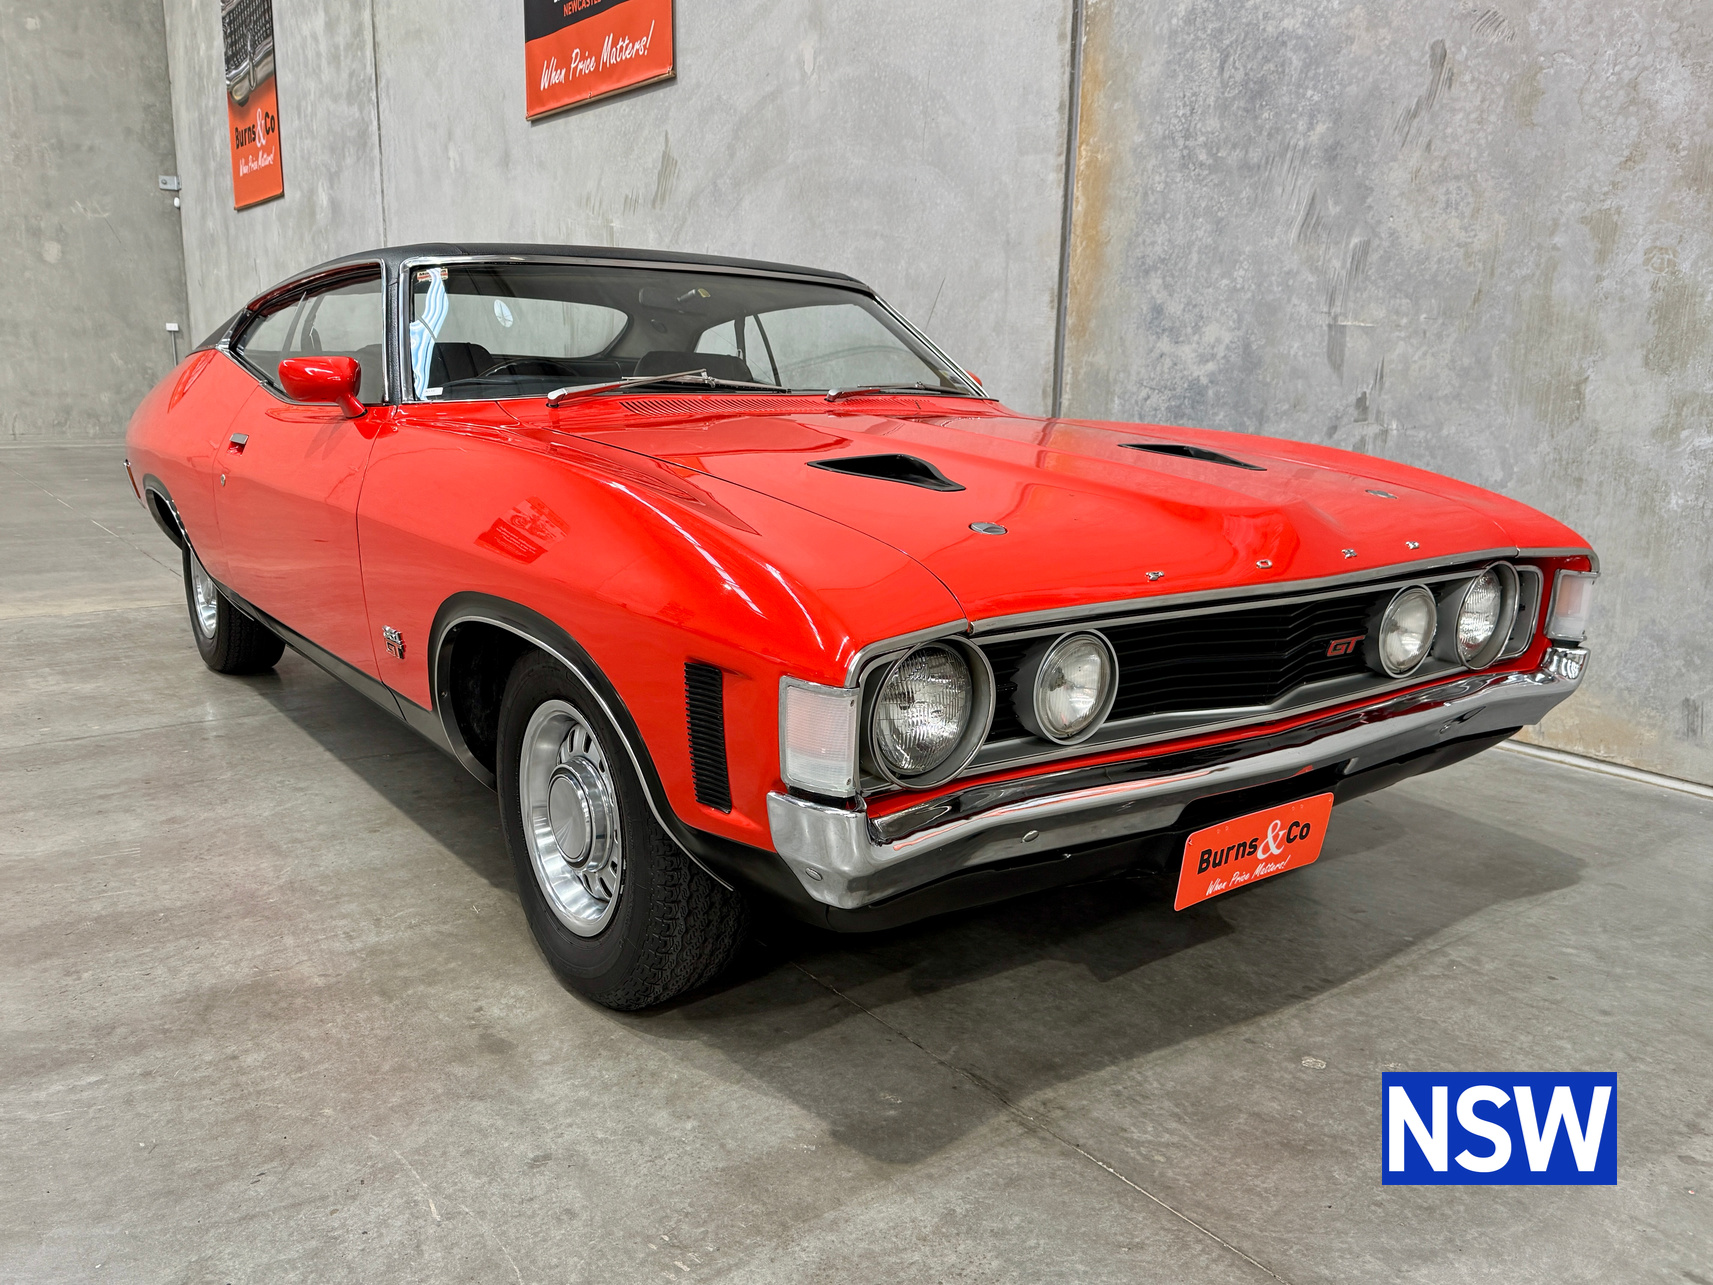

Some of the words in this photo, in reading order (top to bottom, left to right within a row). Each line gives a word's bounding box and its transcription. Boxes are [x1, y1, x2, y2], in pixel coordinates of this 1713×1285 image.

[563, 0, 602, 17] NEWCAS
[540, 56, 565, 91] When
[569, 48, 596, 81] Price
[599, 20, 655, 71] Matters!
[1326, 635, 1366, 657] GT
[1206, 878, 1226, 896] When
[1229, 871, 1250, 886] Price
[1251, 855, 1291, 880] Matters!
